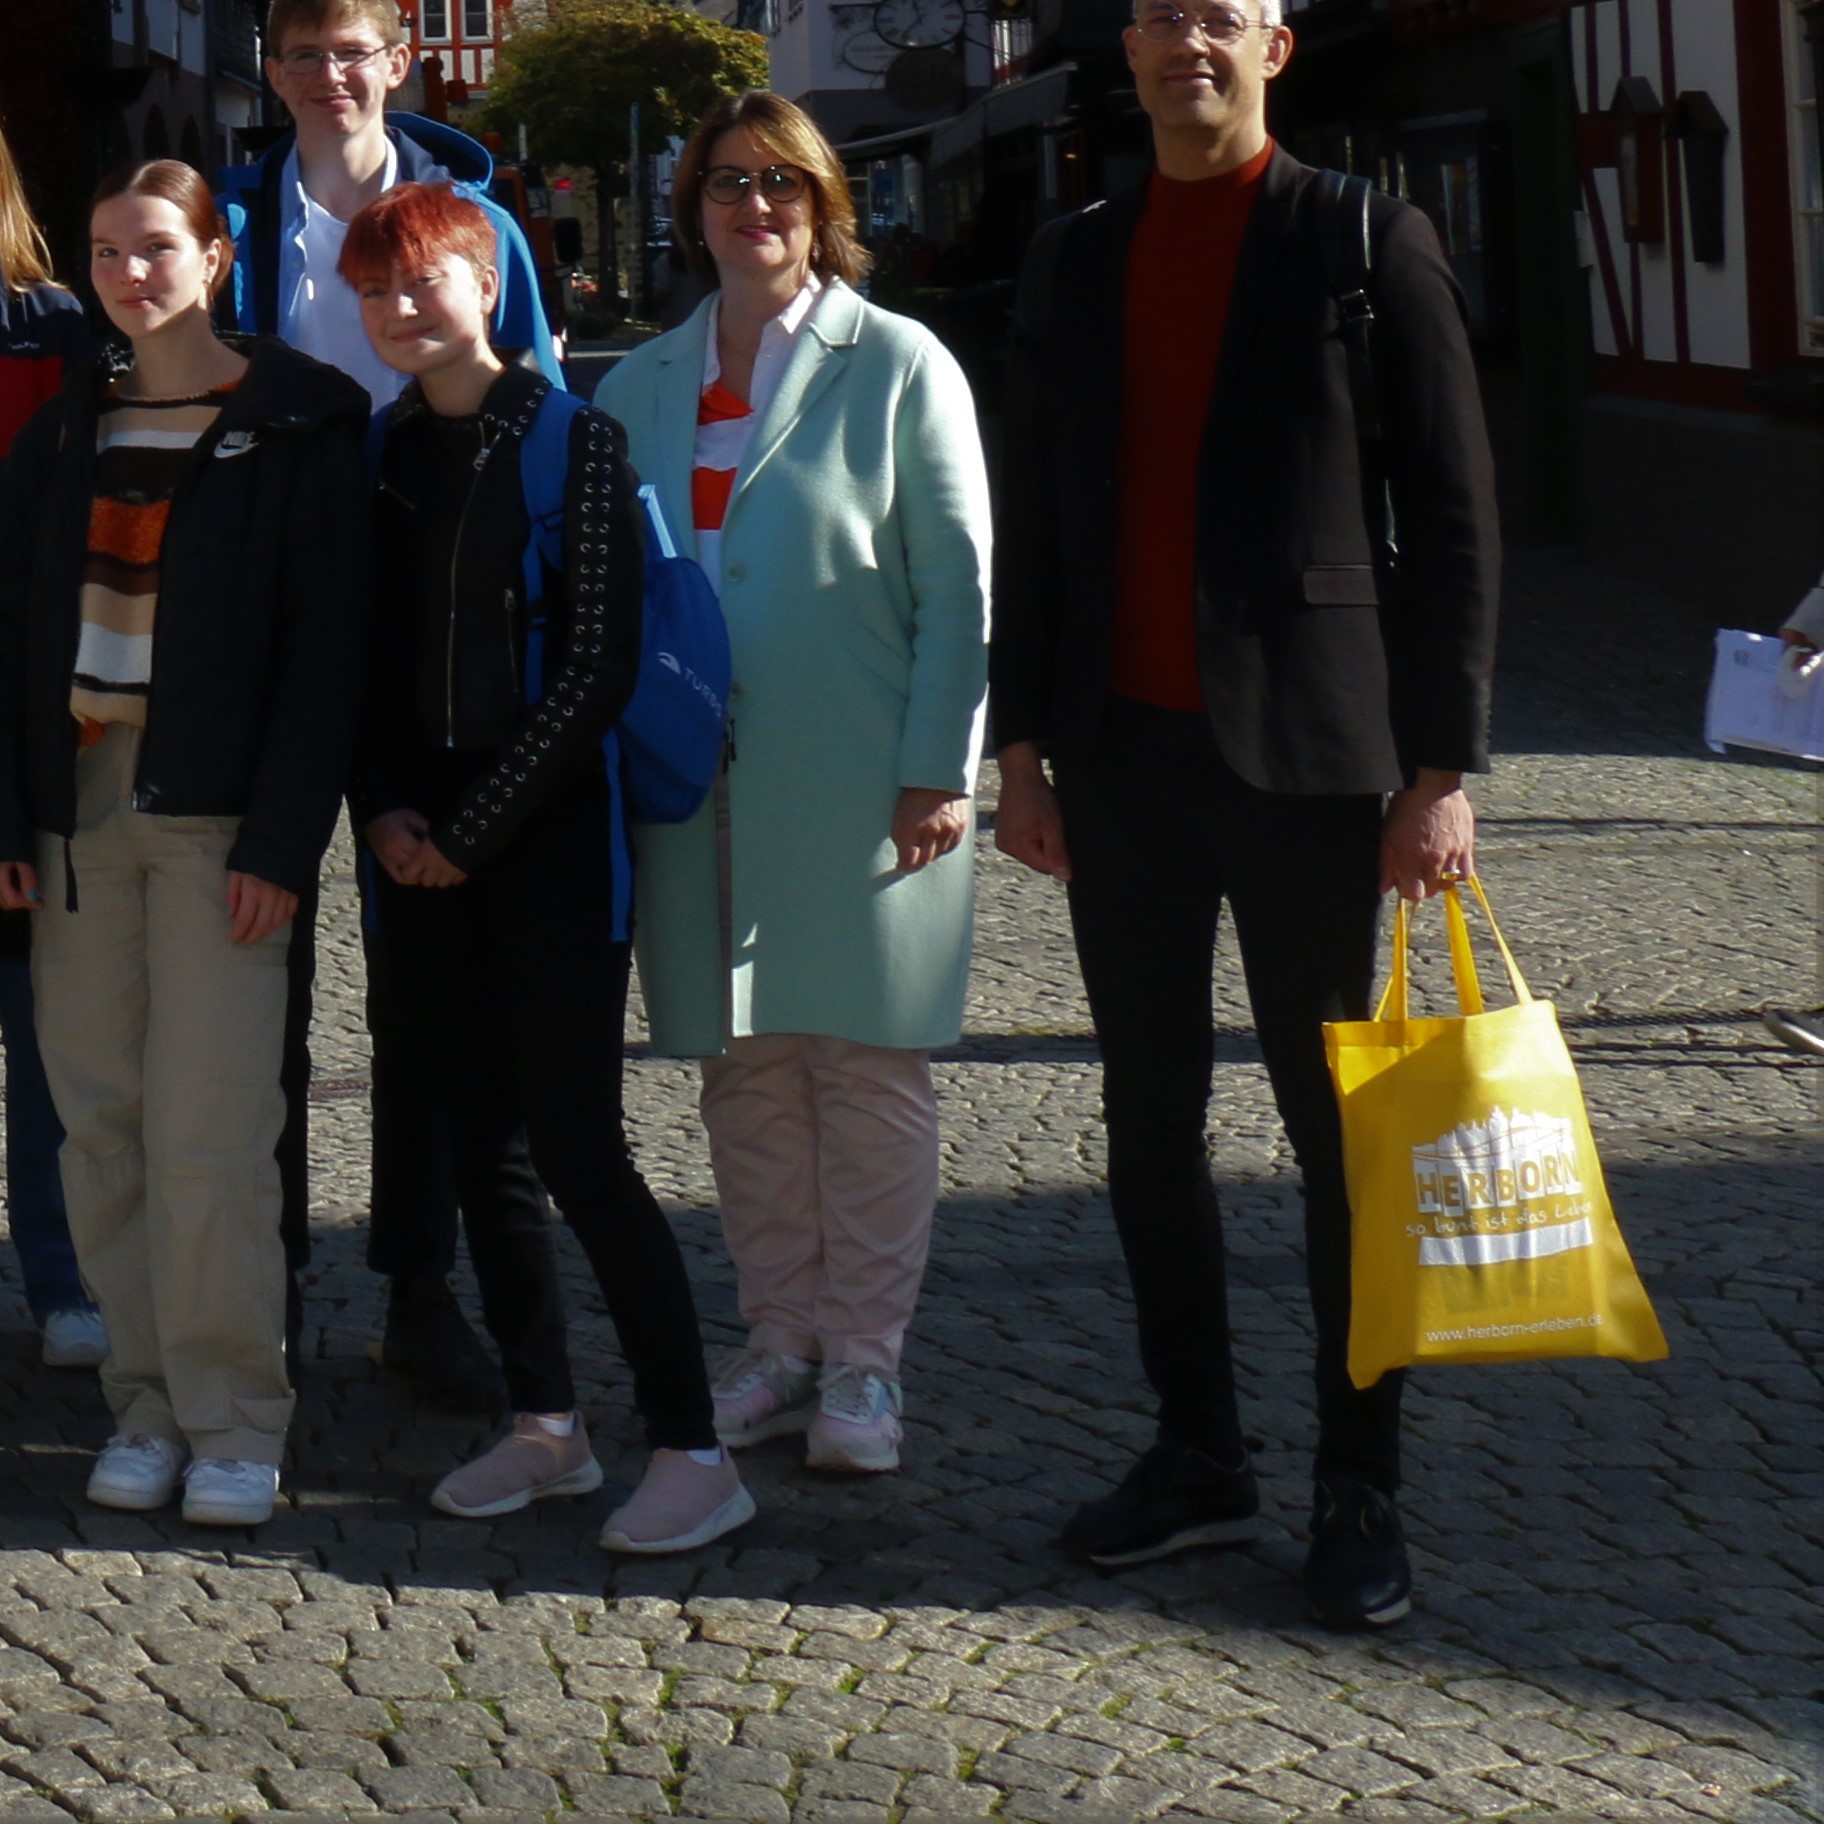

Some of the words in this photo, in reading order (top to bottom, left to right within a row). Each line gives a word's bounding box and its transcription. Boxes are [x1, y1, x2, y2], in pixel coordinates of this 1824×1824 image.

[1416, 1152, 1581, 1207] HERBORN
[1405, 1223, 1426, 1237] so
[1434, 1216, 1478, 1233] bunt
[1484, 1211, 1507, 1229] ist
[1425, 1312, 1603, 1342] www.herborn-erleben.de
